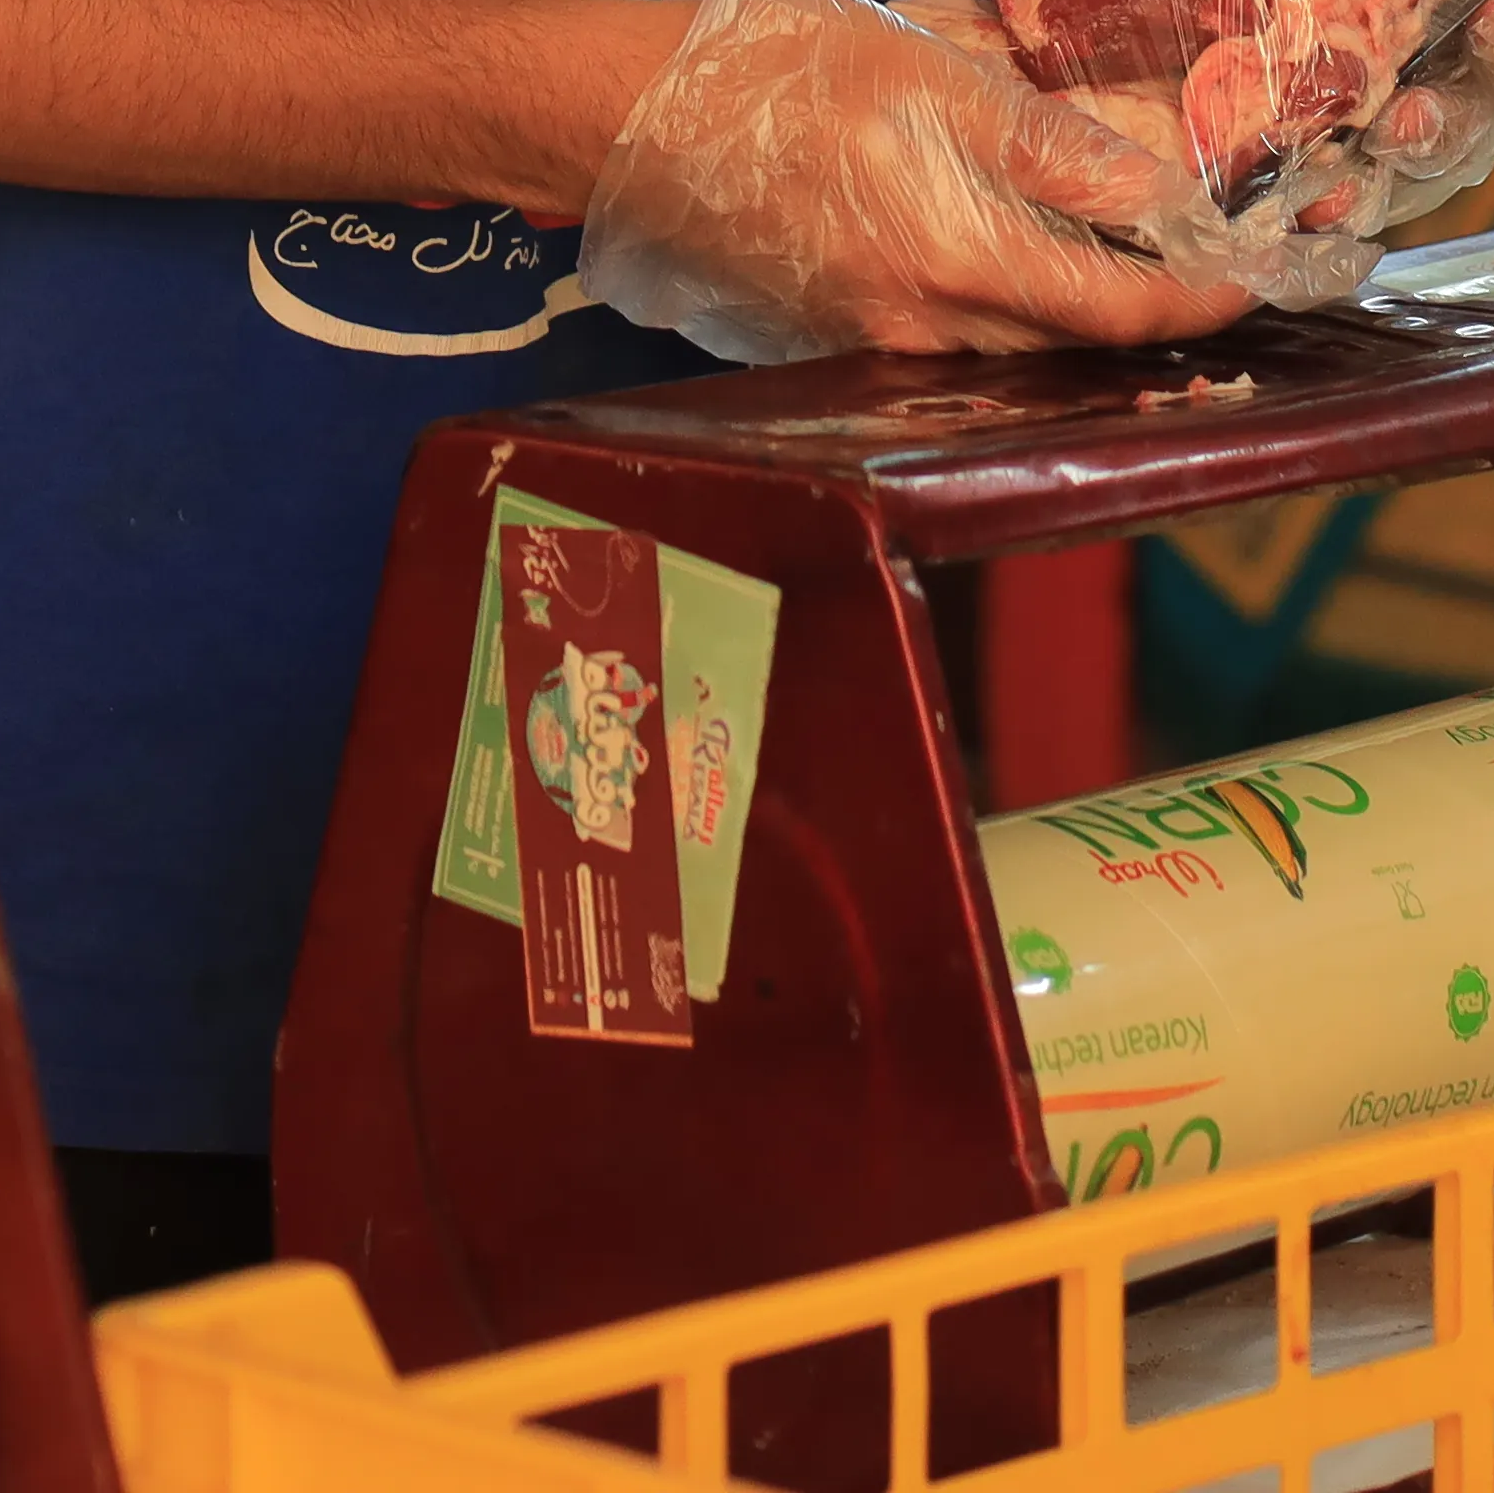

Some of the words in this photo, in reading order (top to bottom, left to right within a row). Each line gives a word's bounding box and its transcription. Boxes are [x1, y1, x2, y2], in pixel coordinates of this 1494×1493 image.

[273, 208, 396, 269] محتاج
[412, 207, 514, 274] كل
[1088, 850, 1226, 900] Wrap
[1109, 1014, 1209, 1059] Korean
[1338, 1079, 1479, 1131] technology
